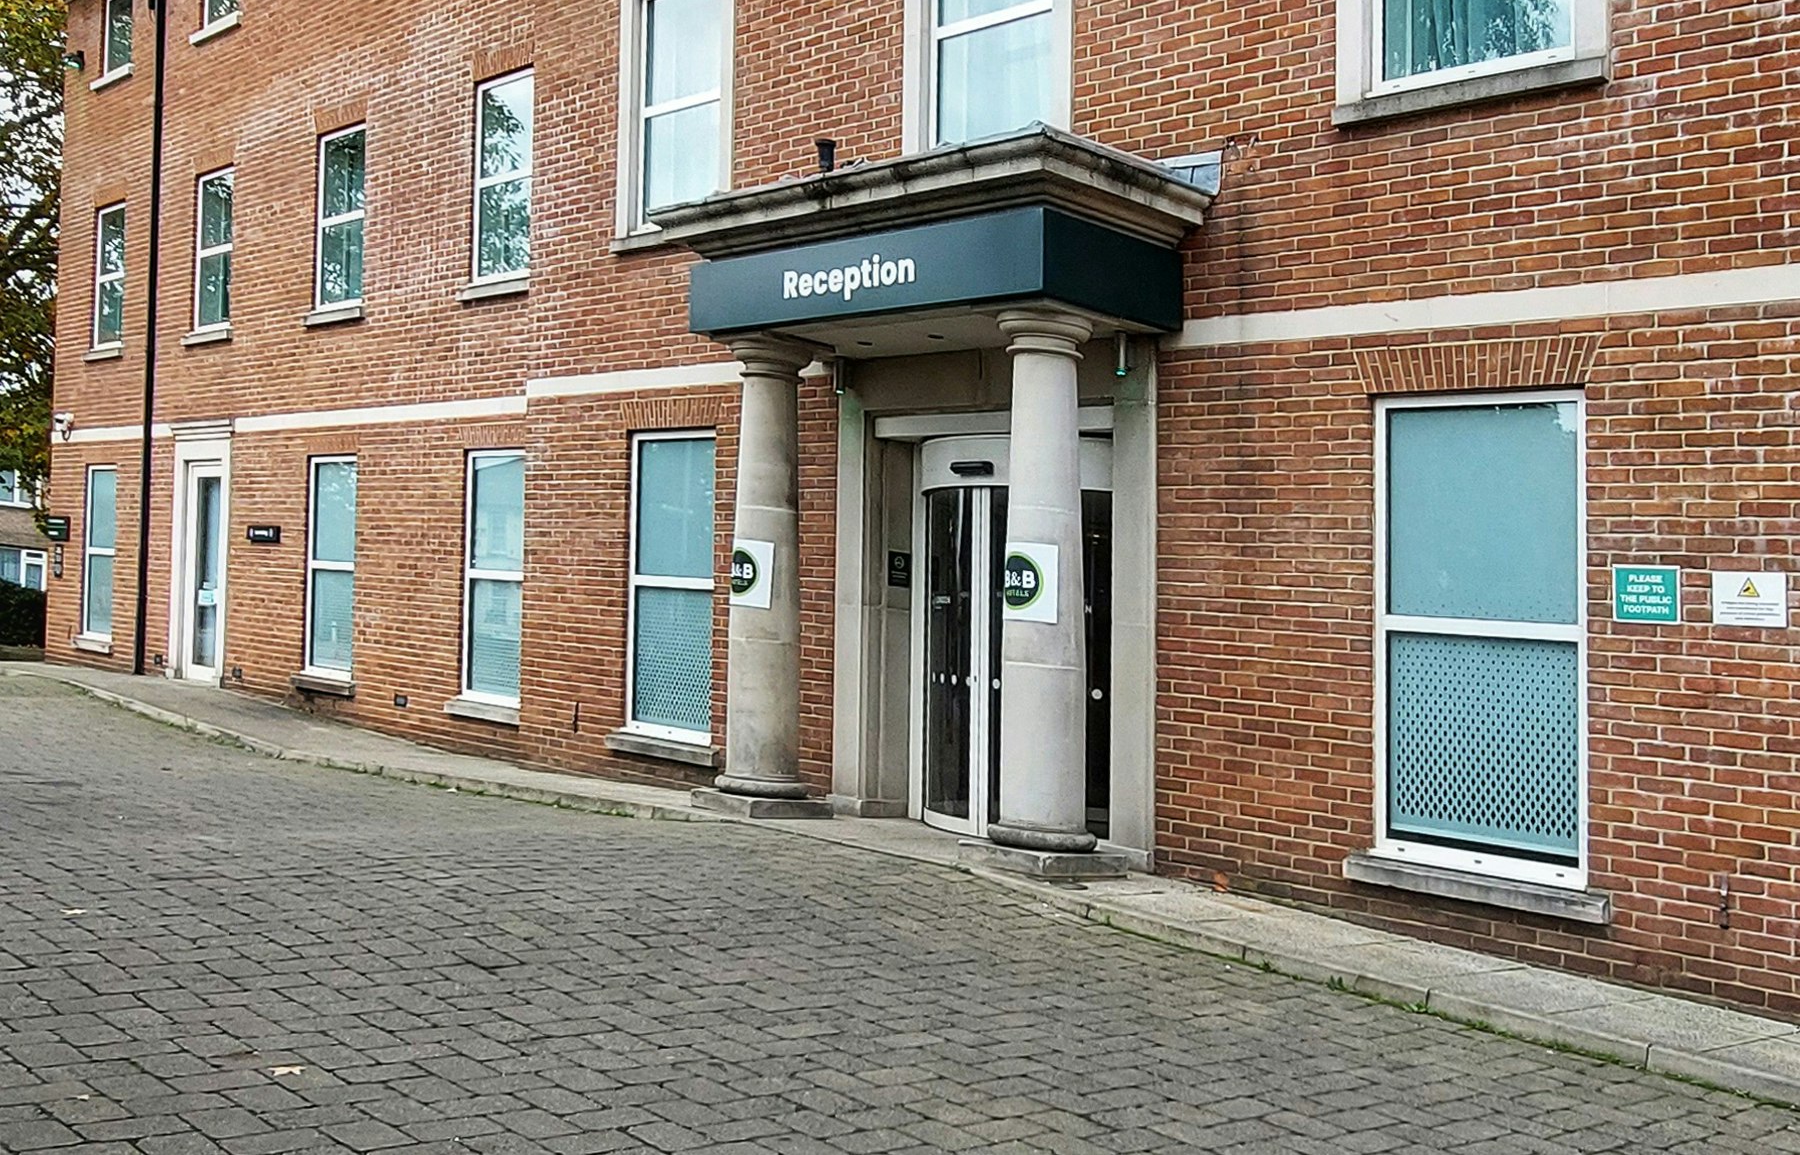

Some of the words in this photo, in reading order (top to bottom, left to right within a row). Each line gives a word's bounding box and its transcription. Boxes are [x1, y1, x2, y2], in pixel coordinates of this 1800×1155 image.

[783, 253, 916, 301] Reception
[1628, 574, 1664, 584] PLEASE
[1627, 584, 1650, 593] KEEP
[1652, 585, 1665, 594] TO
[1620, 594, 1638, 603] THE
[1639, 595, 1673, 605] PUBLIC
[1623, 604, 1669, 615] FOOTPATH
